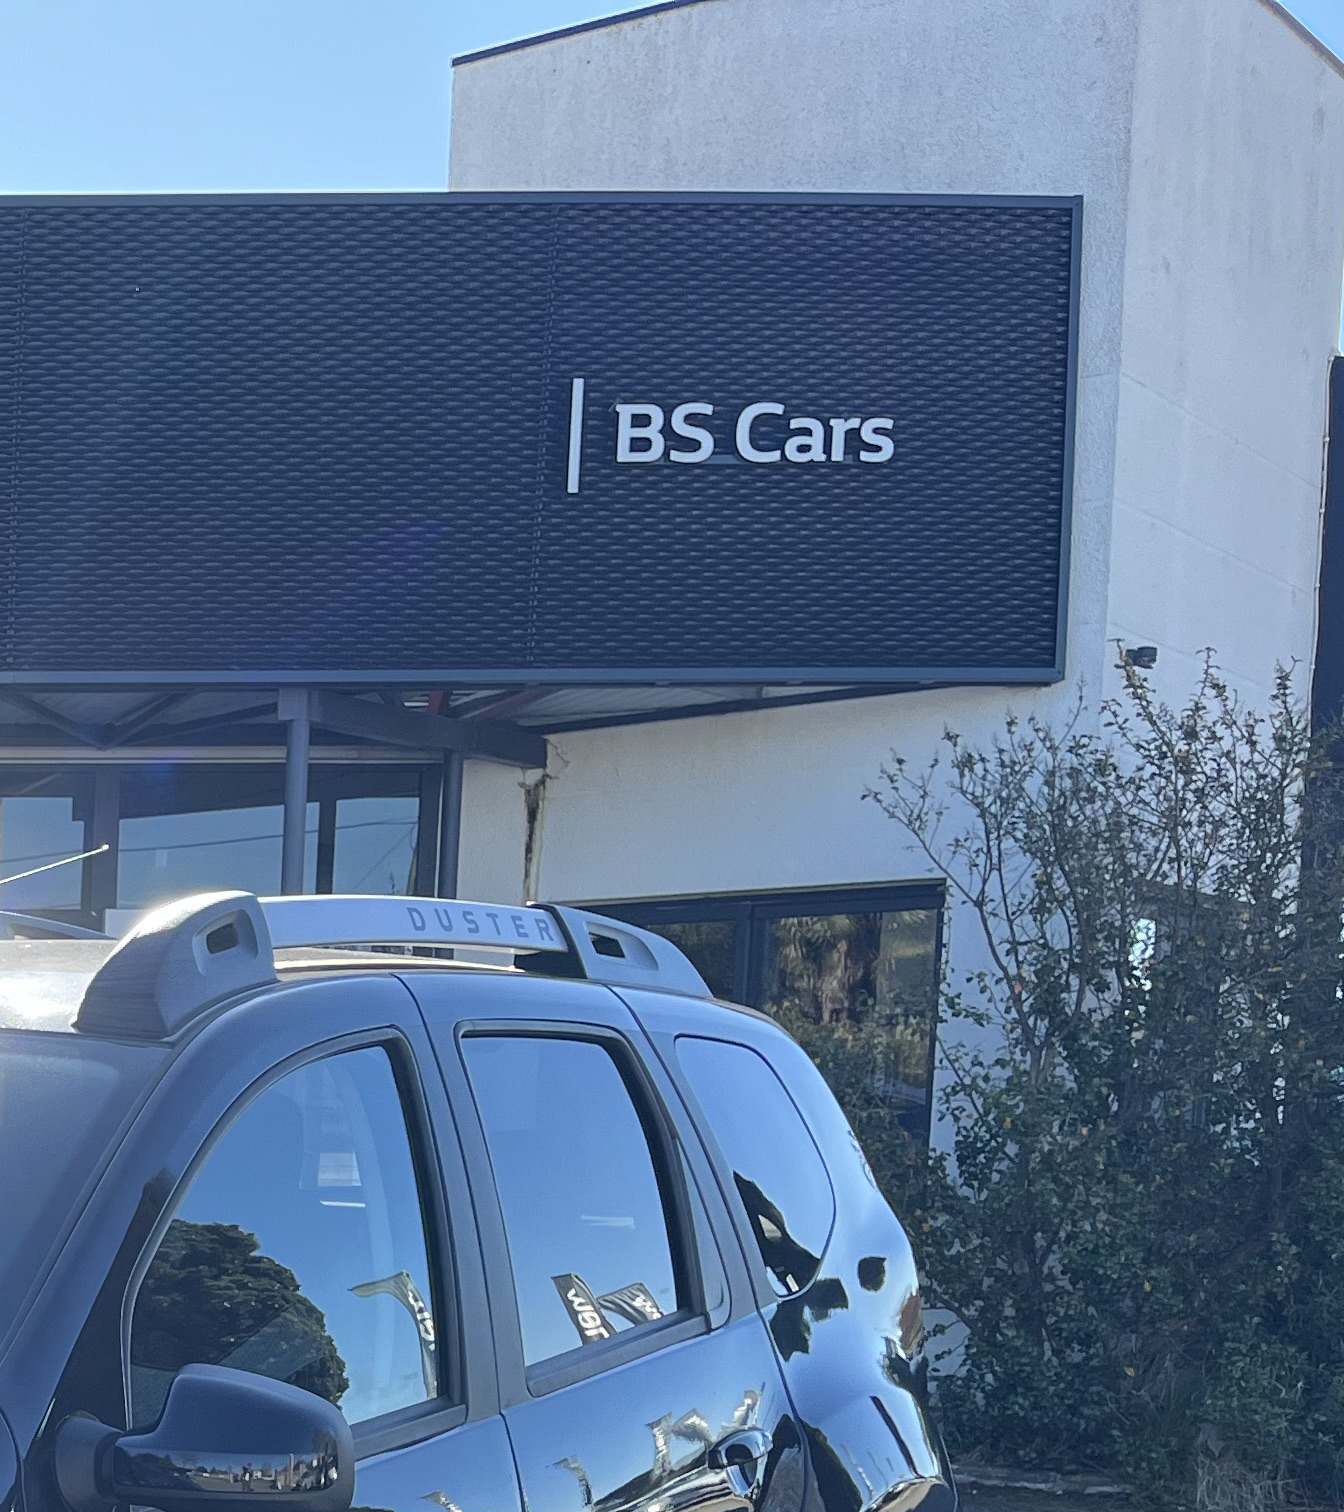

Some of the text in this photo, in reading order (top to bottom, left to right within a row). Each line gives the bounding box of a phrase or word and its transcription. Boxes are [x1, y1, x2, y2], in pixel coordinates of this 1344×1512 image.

[615, 402, 895, 463] BS Cars
[407, 907, 555, 942] DUSTER
